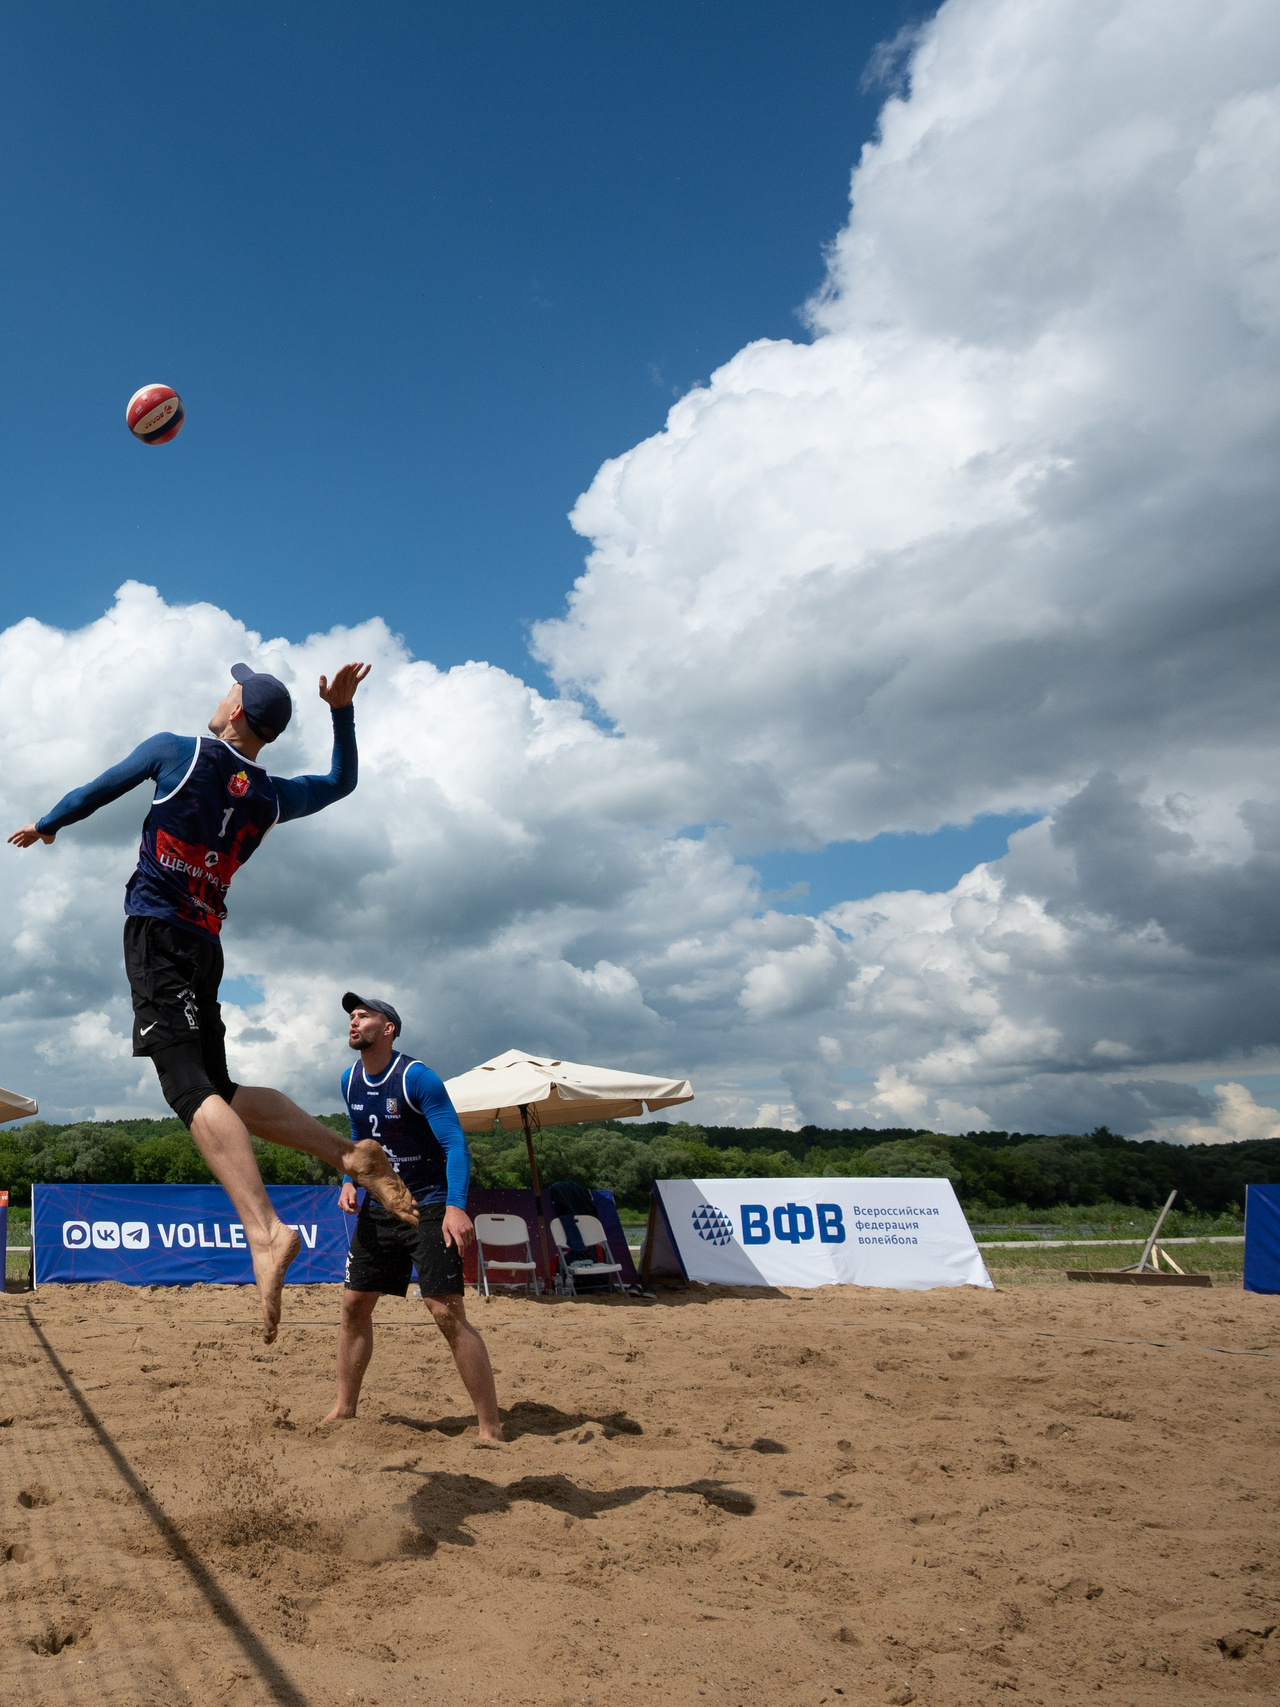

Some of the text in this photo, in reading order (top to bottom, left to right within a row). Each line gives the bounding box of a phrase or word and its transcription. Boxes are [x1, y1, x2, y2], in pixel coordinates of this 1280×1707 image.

[218, 807, 234, 837] 1
[369, 1114, 381, 1137] 2
[853, 1206, 939, 1217] Всероссийская
[740, 1202, 846, 1245] ВФВ
[855, 1220, 919, 1231] федерация
[858, 1234, 918, 1245] волейбола
